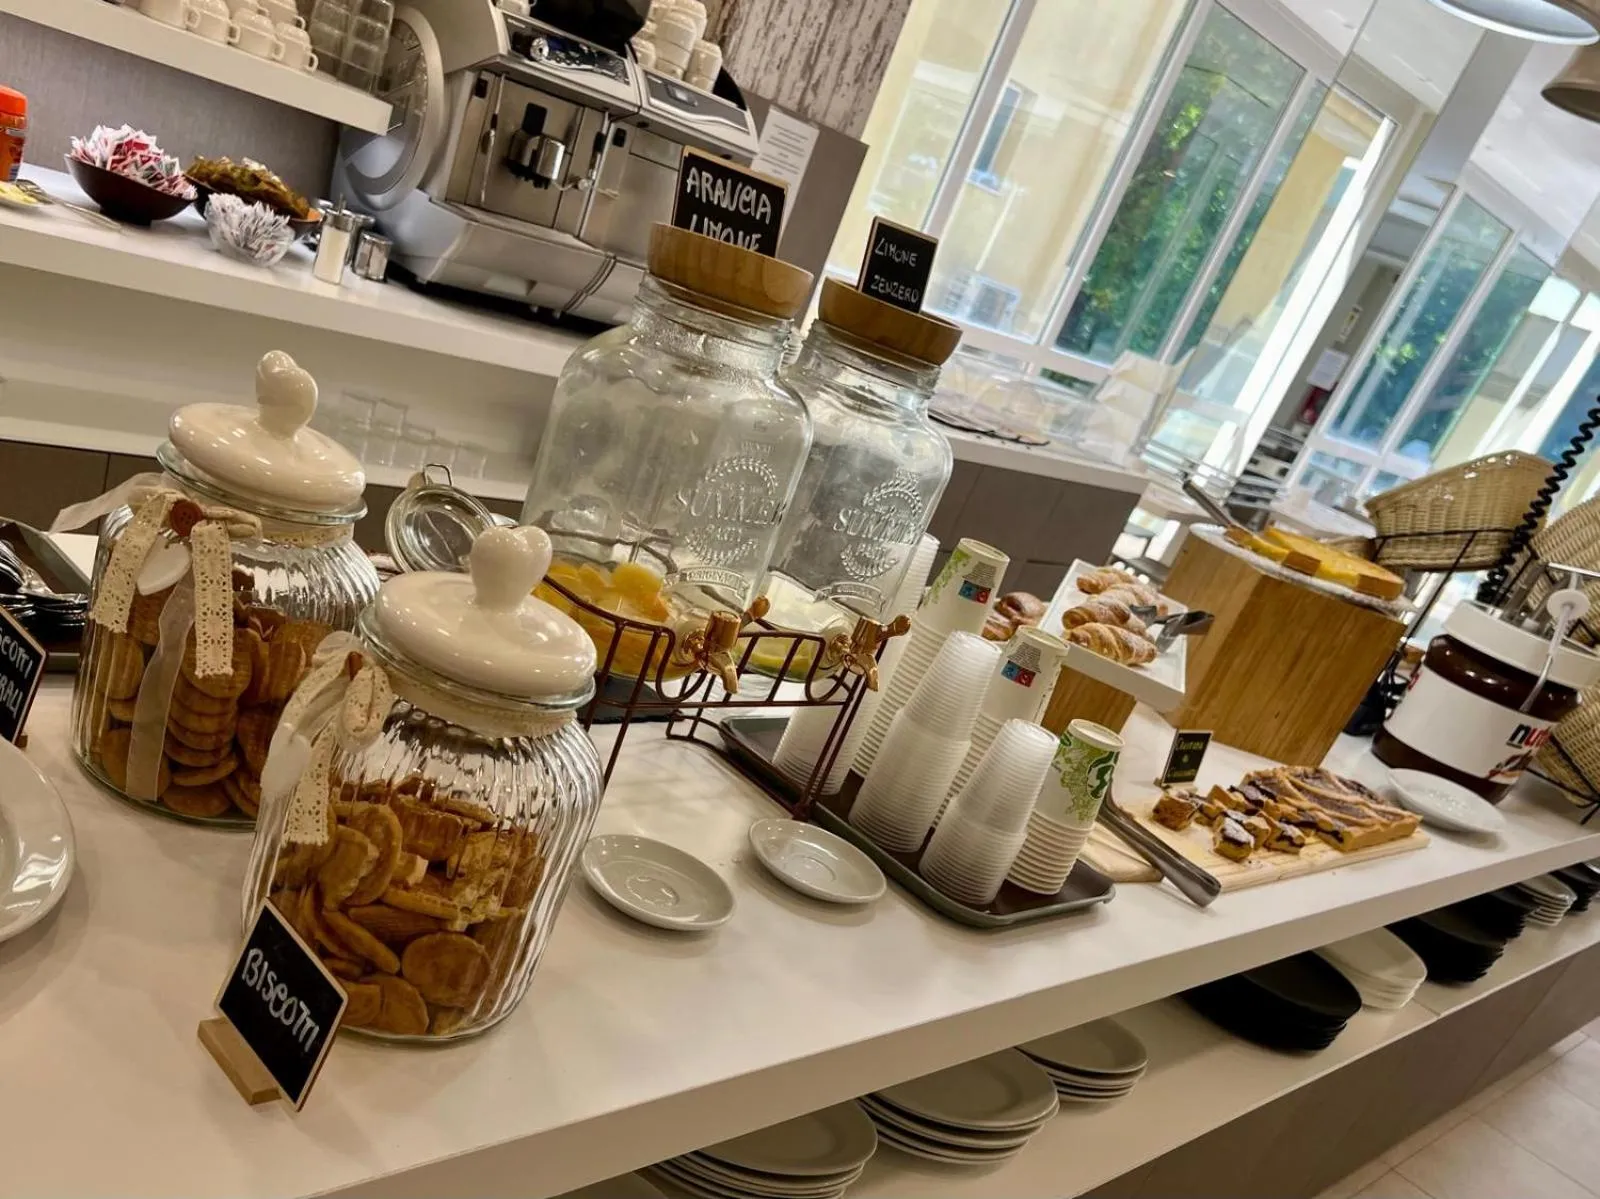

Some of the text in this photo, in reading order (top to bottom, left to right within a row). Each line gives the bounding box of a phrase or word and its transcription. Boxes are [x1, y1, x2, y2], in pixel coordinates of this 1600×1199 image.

[686, 166, 772, 225] ARANCIA
[874, 237, 919, 268] LIMONE
[870, 274, 920, 303] ZENZERO
[242, 948, 320, 1053] BISCOTTI
